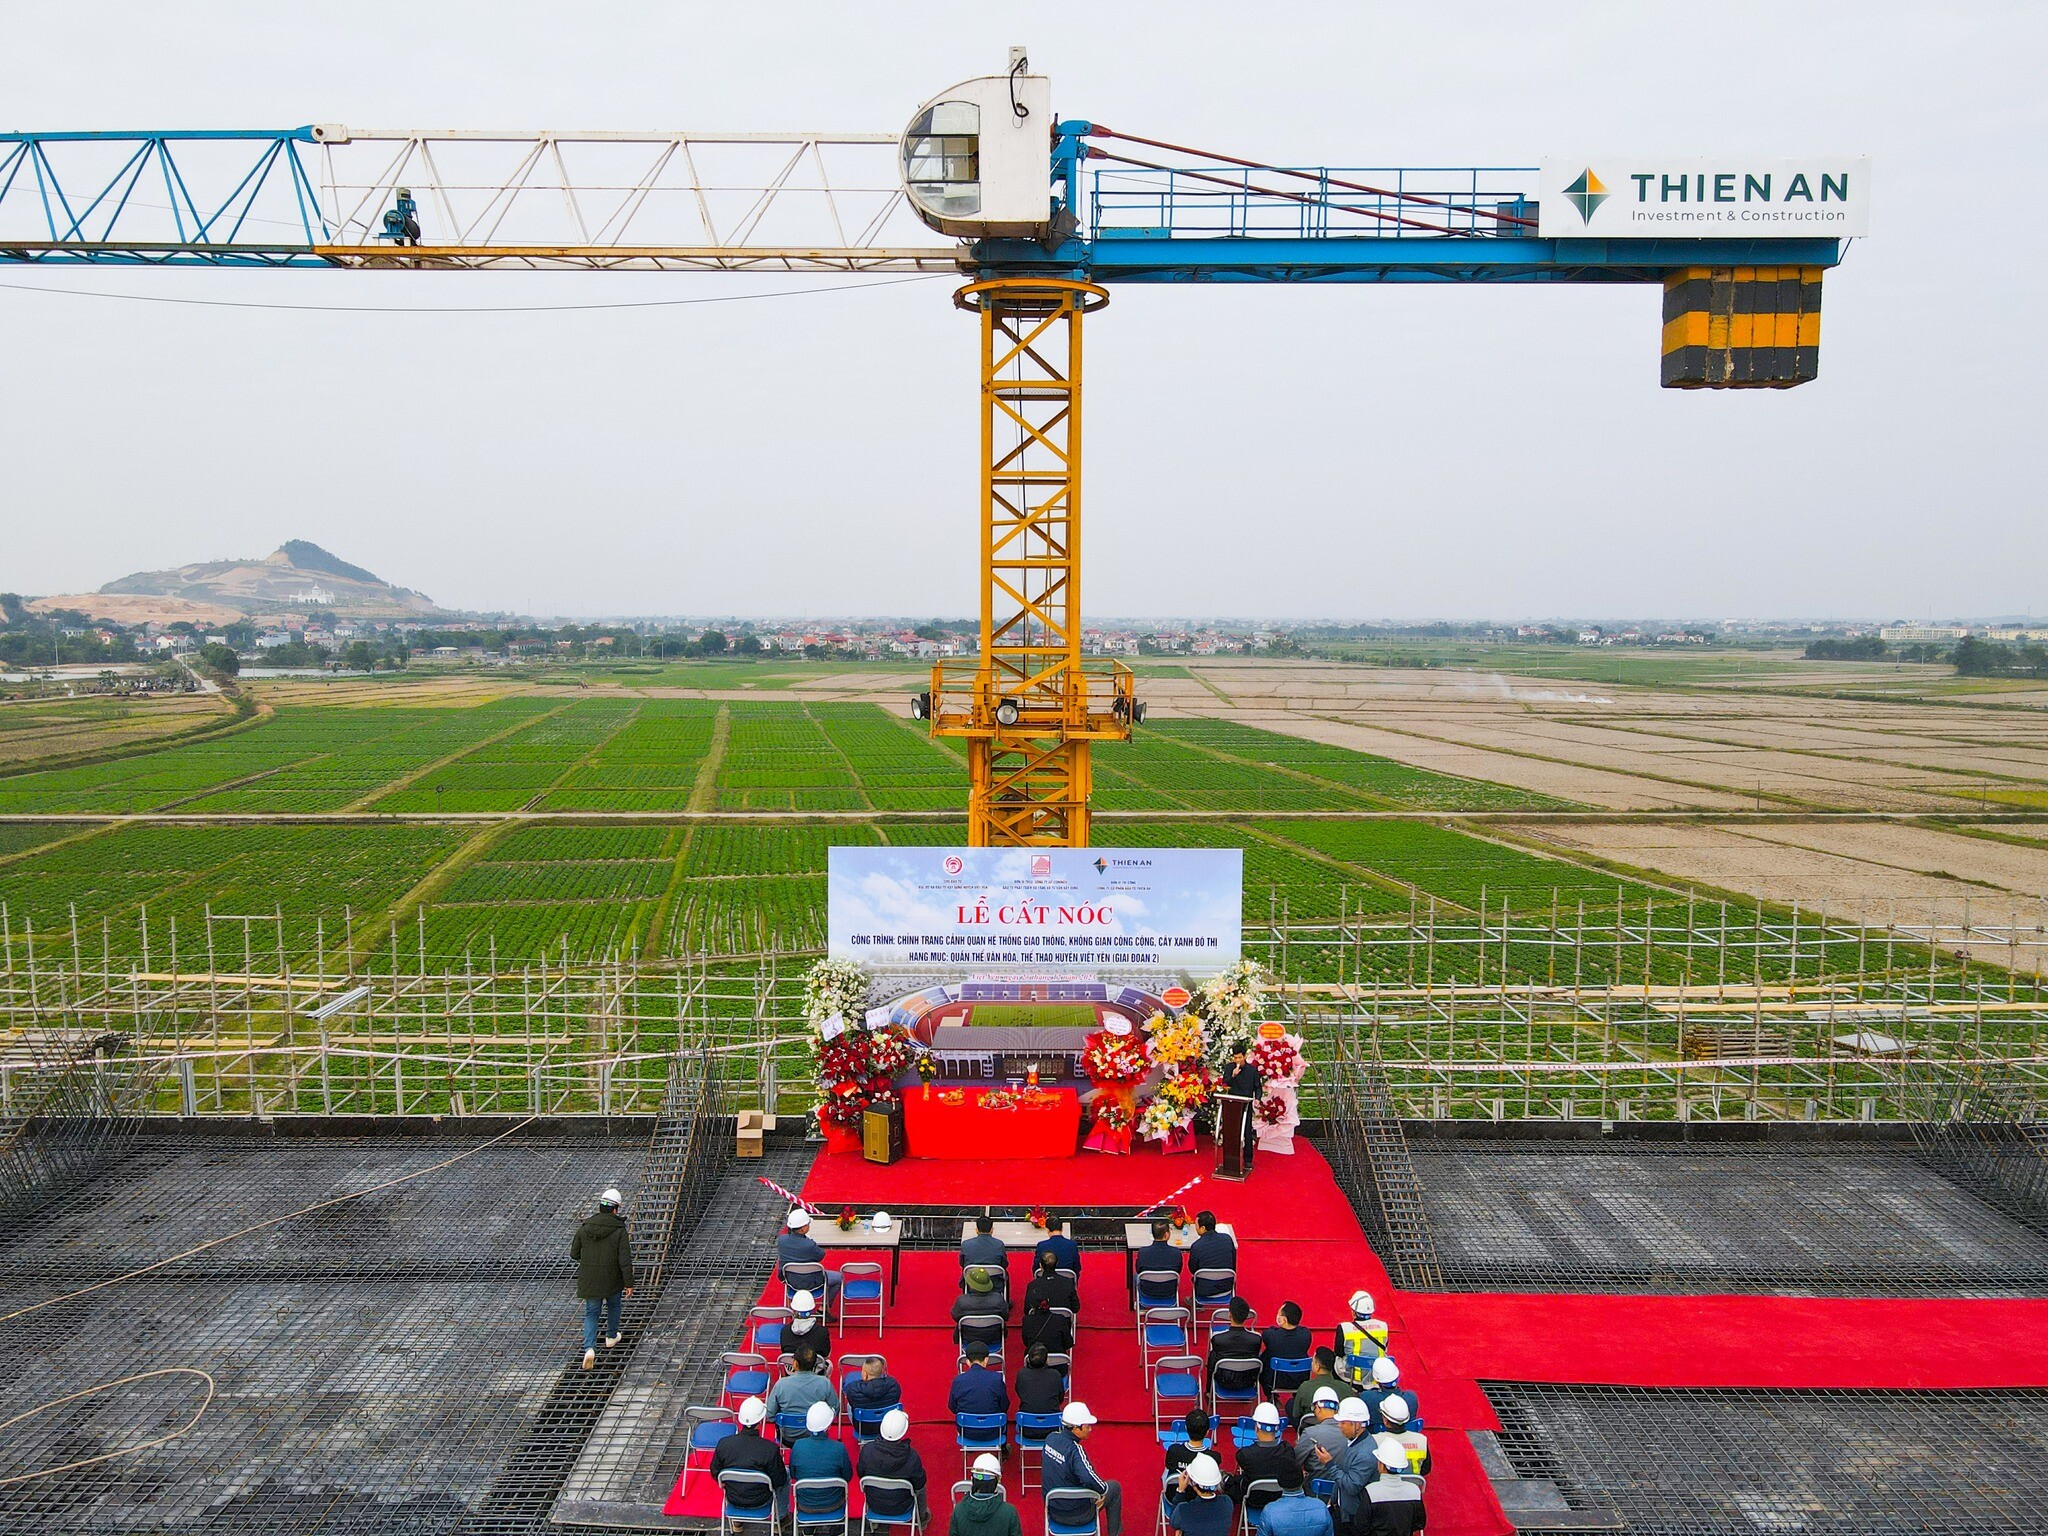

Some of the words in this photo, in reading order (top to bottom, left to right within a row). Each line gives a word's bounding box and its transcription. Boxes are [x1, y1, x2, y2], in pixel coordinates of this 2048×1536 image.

[1630, 173, 1771, 202] THIEN
[1783, 173, 1849, 202] AN
[1631, 210, 1722, 221] Investment
[1727, 210, 1737, 221] &
[1740, 209, 1845, 221] Construction
[956, 895, 990, 924] LỄ
[998, 897, 1050, 925] CẤT
[1057, 900, 1113, 925] NÓC
[851, 932, 871, 945] CÔNG
[872, 933, 896, 945] TRÌNH:
[921, 935, 944, 946] TRANG
[966, 935, 986, 946] QUAN
[1023, 935, 1040, 946] GIAO
[1042, 933, 1067, 948] THÔNG,
[1069, 934, 1093, 946] KHÔNG
[1094, 936, 1112, 947] GIAN
[1113, 934, 1133, 947] CÔNG
[1158, 934, 1172, 947] CÂY
[1173, 936, 1193, 947] XANH
[1195, 935, 1205, 947] ĐÔ
[1035, 952, 1053, 963] THAO
[1055, 950, 1078, 965] HUYỆN
[1080, 951, 1095, 965] VIỆT
[1096, 951, 1110, 963] YÊN
[1112, 953, 1129, 964] (GIAI
[1152, 953, 1160, 964] 2)
